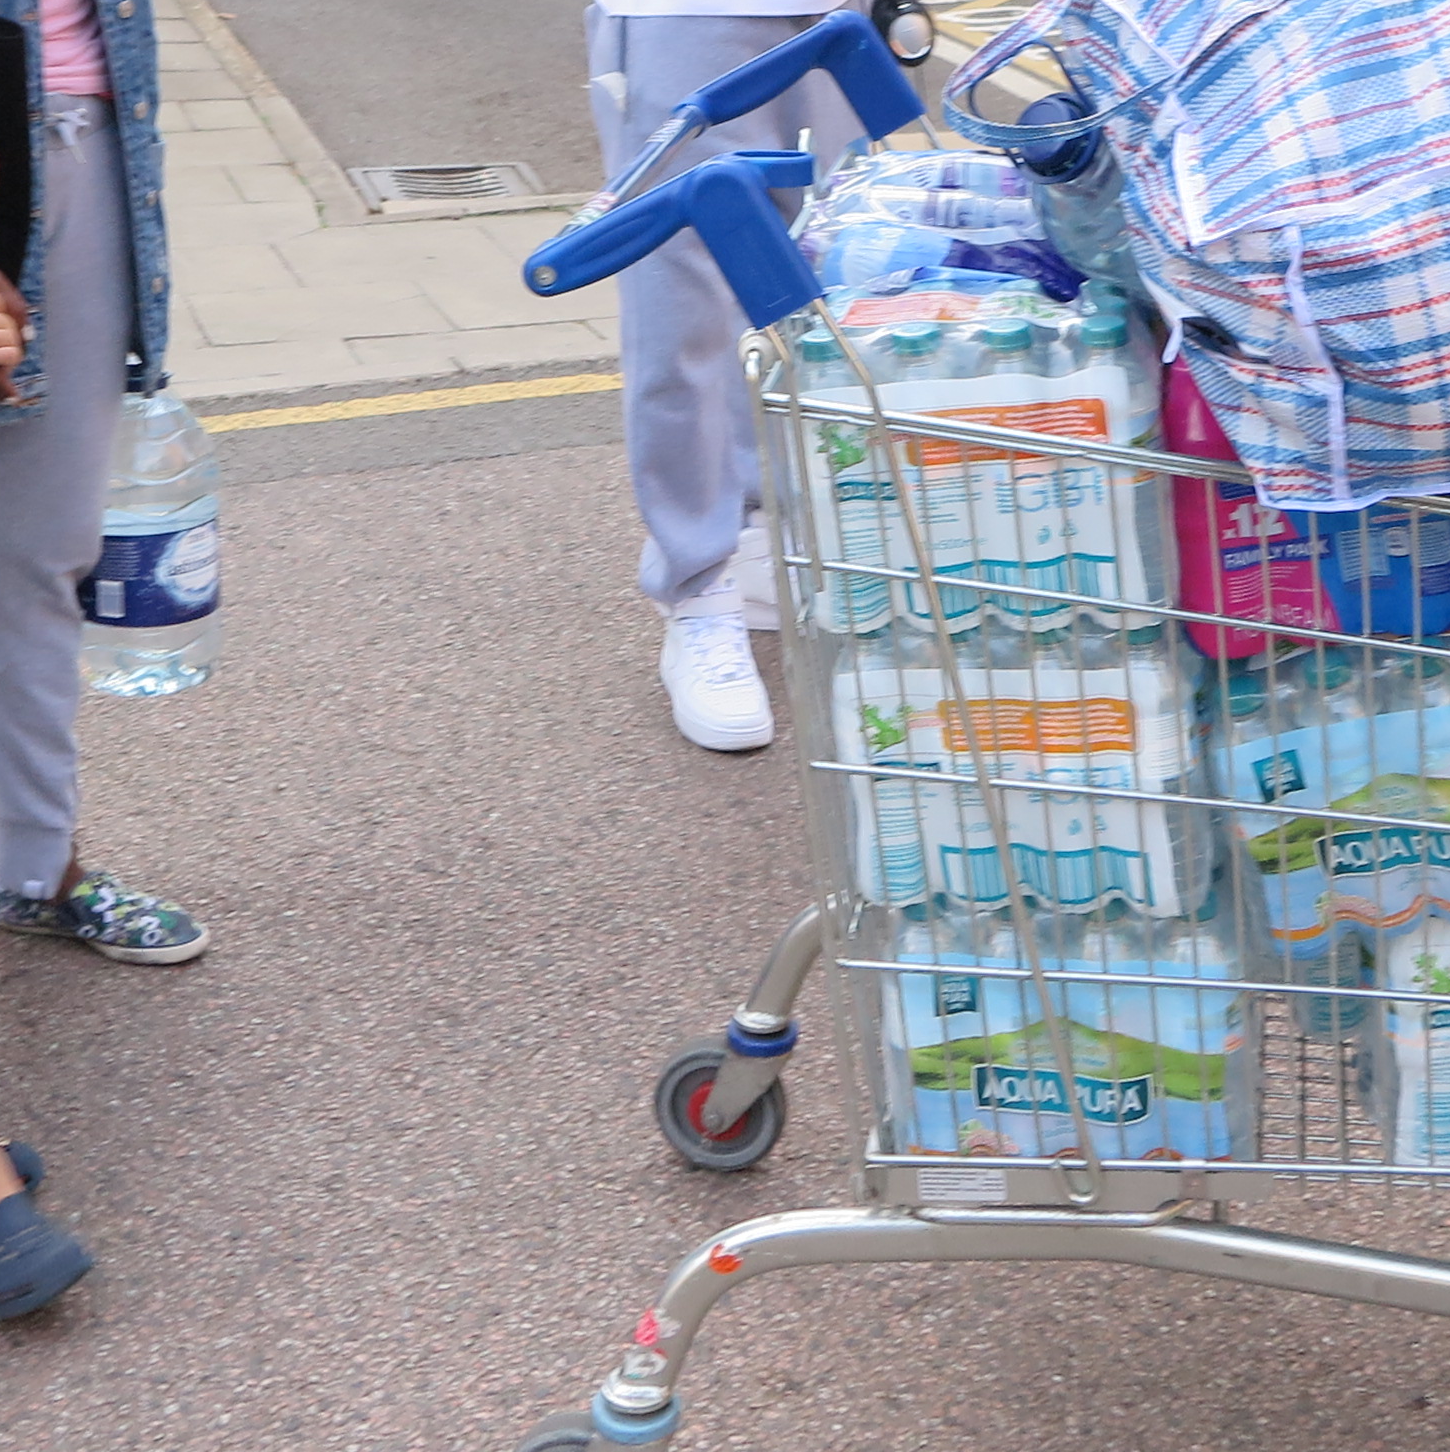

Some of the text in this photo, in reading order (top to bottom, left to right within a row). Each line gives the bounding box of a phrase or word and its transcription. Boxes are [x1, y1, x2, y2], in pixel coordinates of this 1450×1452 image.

[1224, 546, 1284, 569] FAMLY
[1329, 835, 1411, 870] AQUA
[982, 1073, 1063, 1105] AQUA
